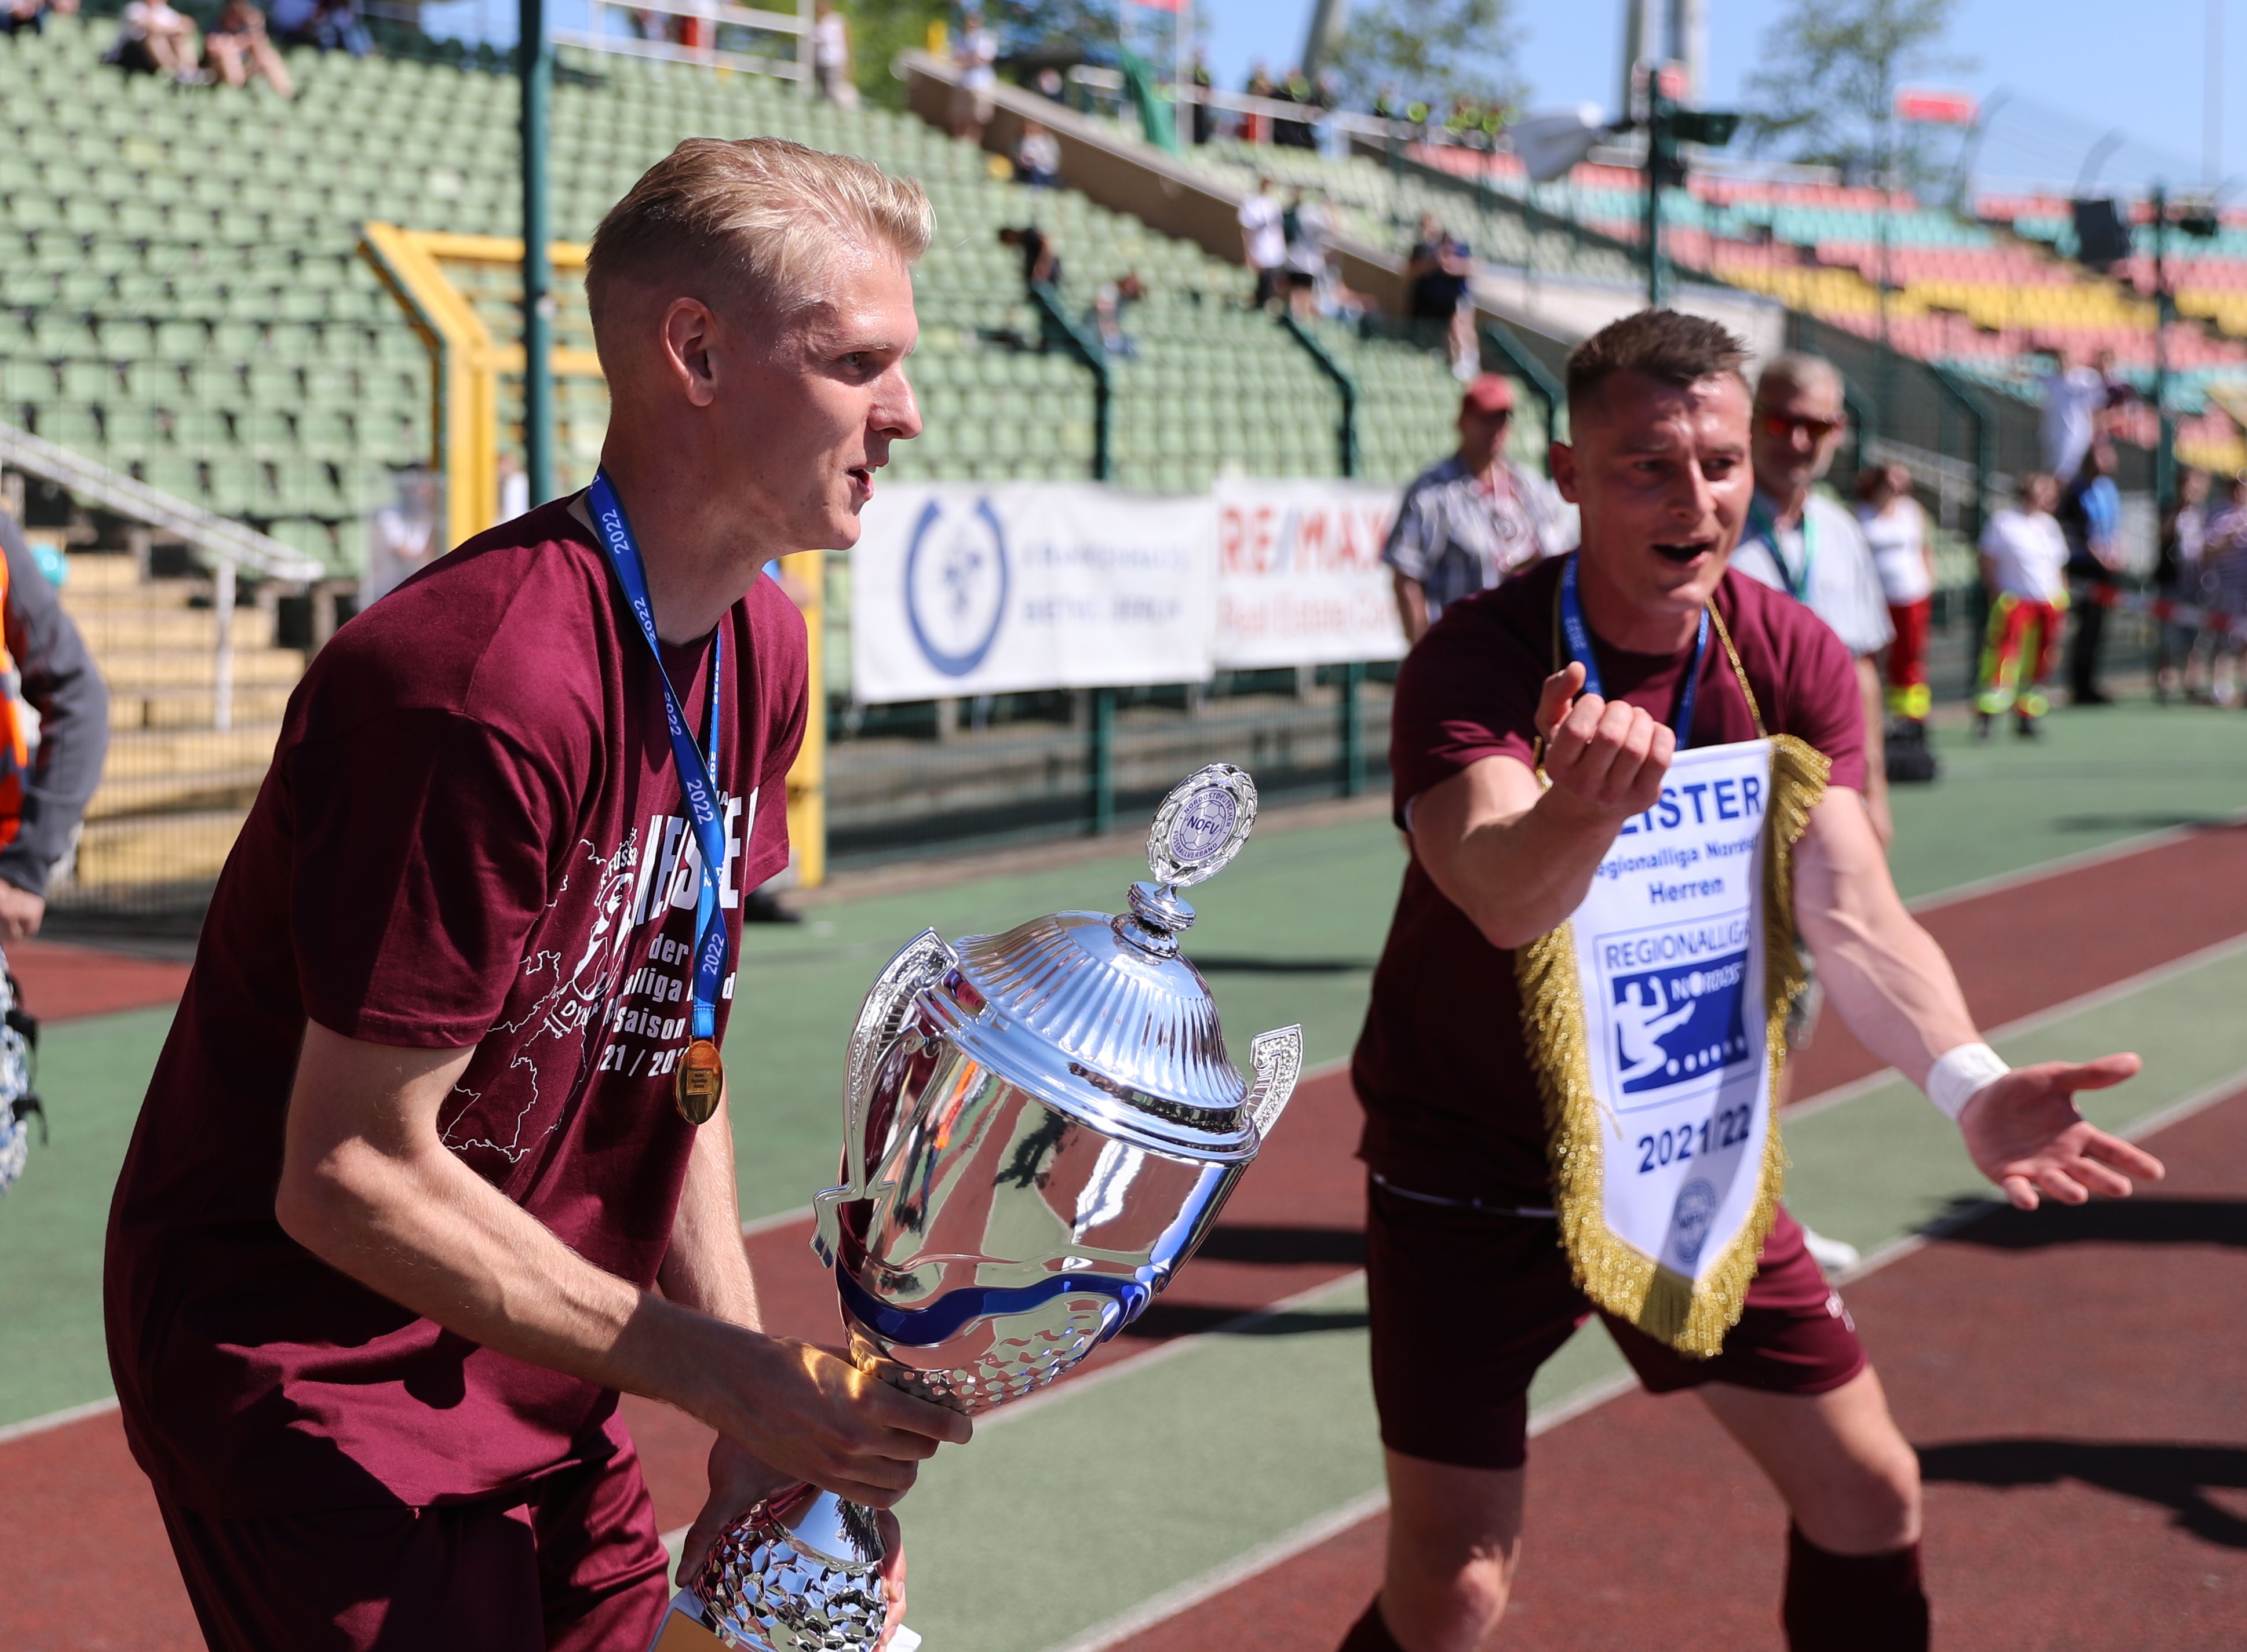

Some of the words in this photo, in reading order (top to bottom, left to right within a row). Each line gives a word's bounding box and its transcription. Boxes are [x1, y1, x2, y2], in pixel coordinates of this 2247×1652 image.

[603, 509, 629, 554] 2022
[634, 597, 656, 642] 2022
[665, 692, 682, 736] 2022
[686, 779, 714, 825] 2022
[1184, 792, 1233, 827] NORDOSTDEUTSCHER
[1621, 777, 1761, 835] ISTER
[1187, 816, 1220, 834] NOFV
[1172, 830, 1217, 858] FUSSBALLVERBAND
[1596, 847, 1699, 880] egionalliga
[1650, 878, 1725, 903] Herren
[649, 933, 689, 966] der
[702, 933, 724, 976] 2022
[623, 967, 683, 1002] alliga
[613, 1006, 686, 1040] Saison
[1639, 1104, 1749, 1173] 2021/22
